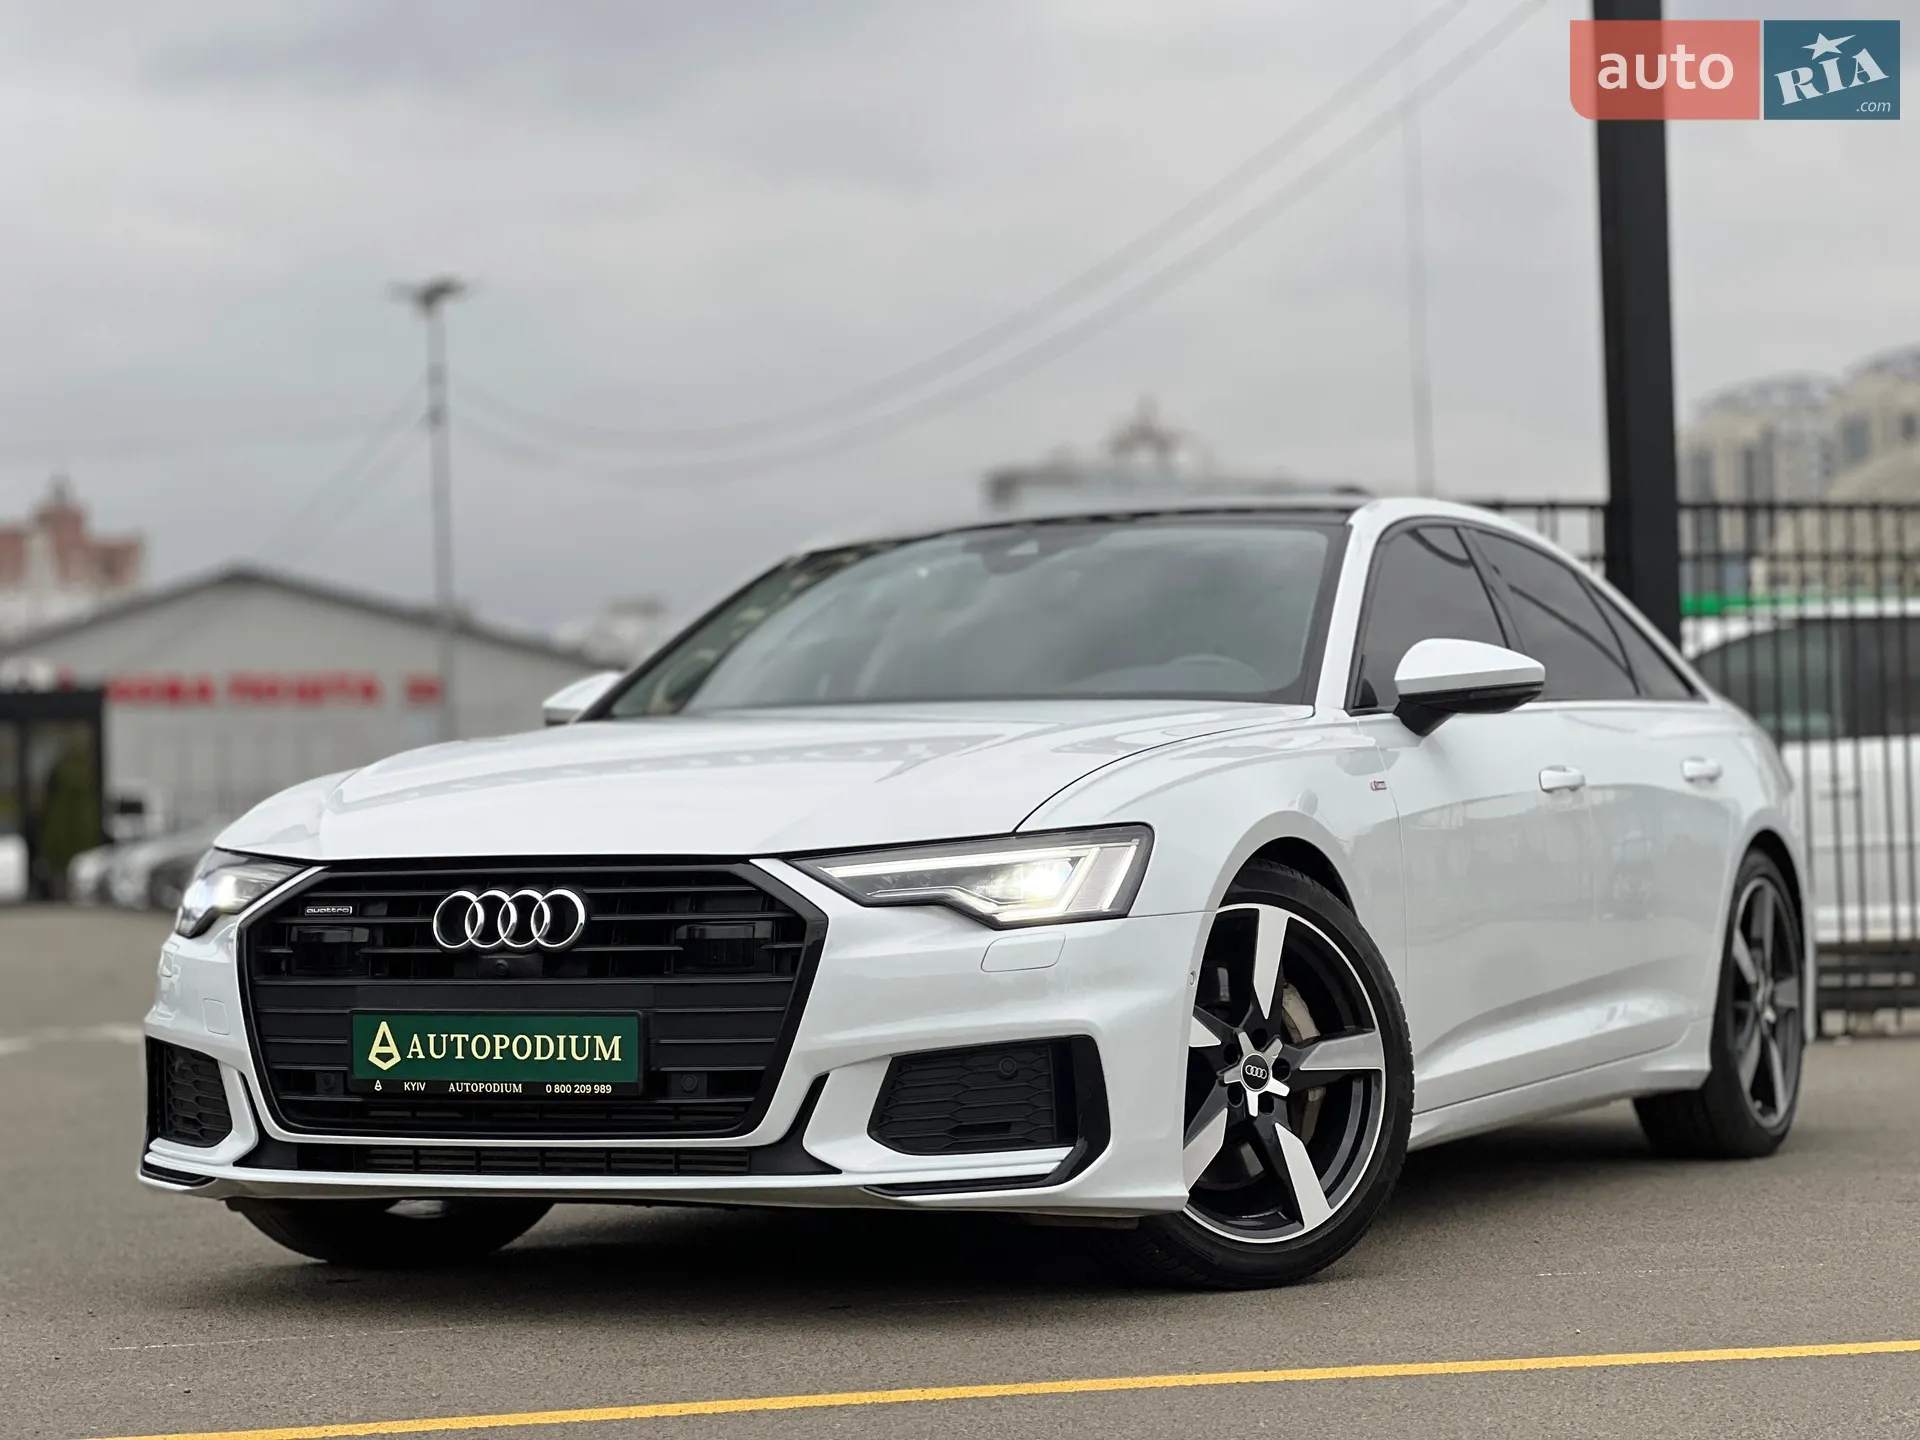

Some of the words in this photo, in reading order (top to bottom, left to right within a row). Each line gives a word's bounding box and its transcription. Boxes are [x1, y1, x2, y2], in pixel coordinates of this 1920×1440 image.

[406, 1033, 622, 1061] AUTOPODIUM
[404, 1081, 426, 1092] KYIV
[448, 1082, 523, 1093] AUTOPODIUM
[545, 1084, 553, 1094] 0
[554, 1084, 572, 1094] 800
[574, 1084, 592, 1094] 209
[593, 1084, 612, 1095] 989
